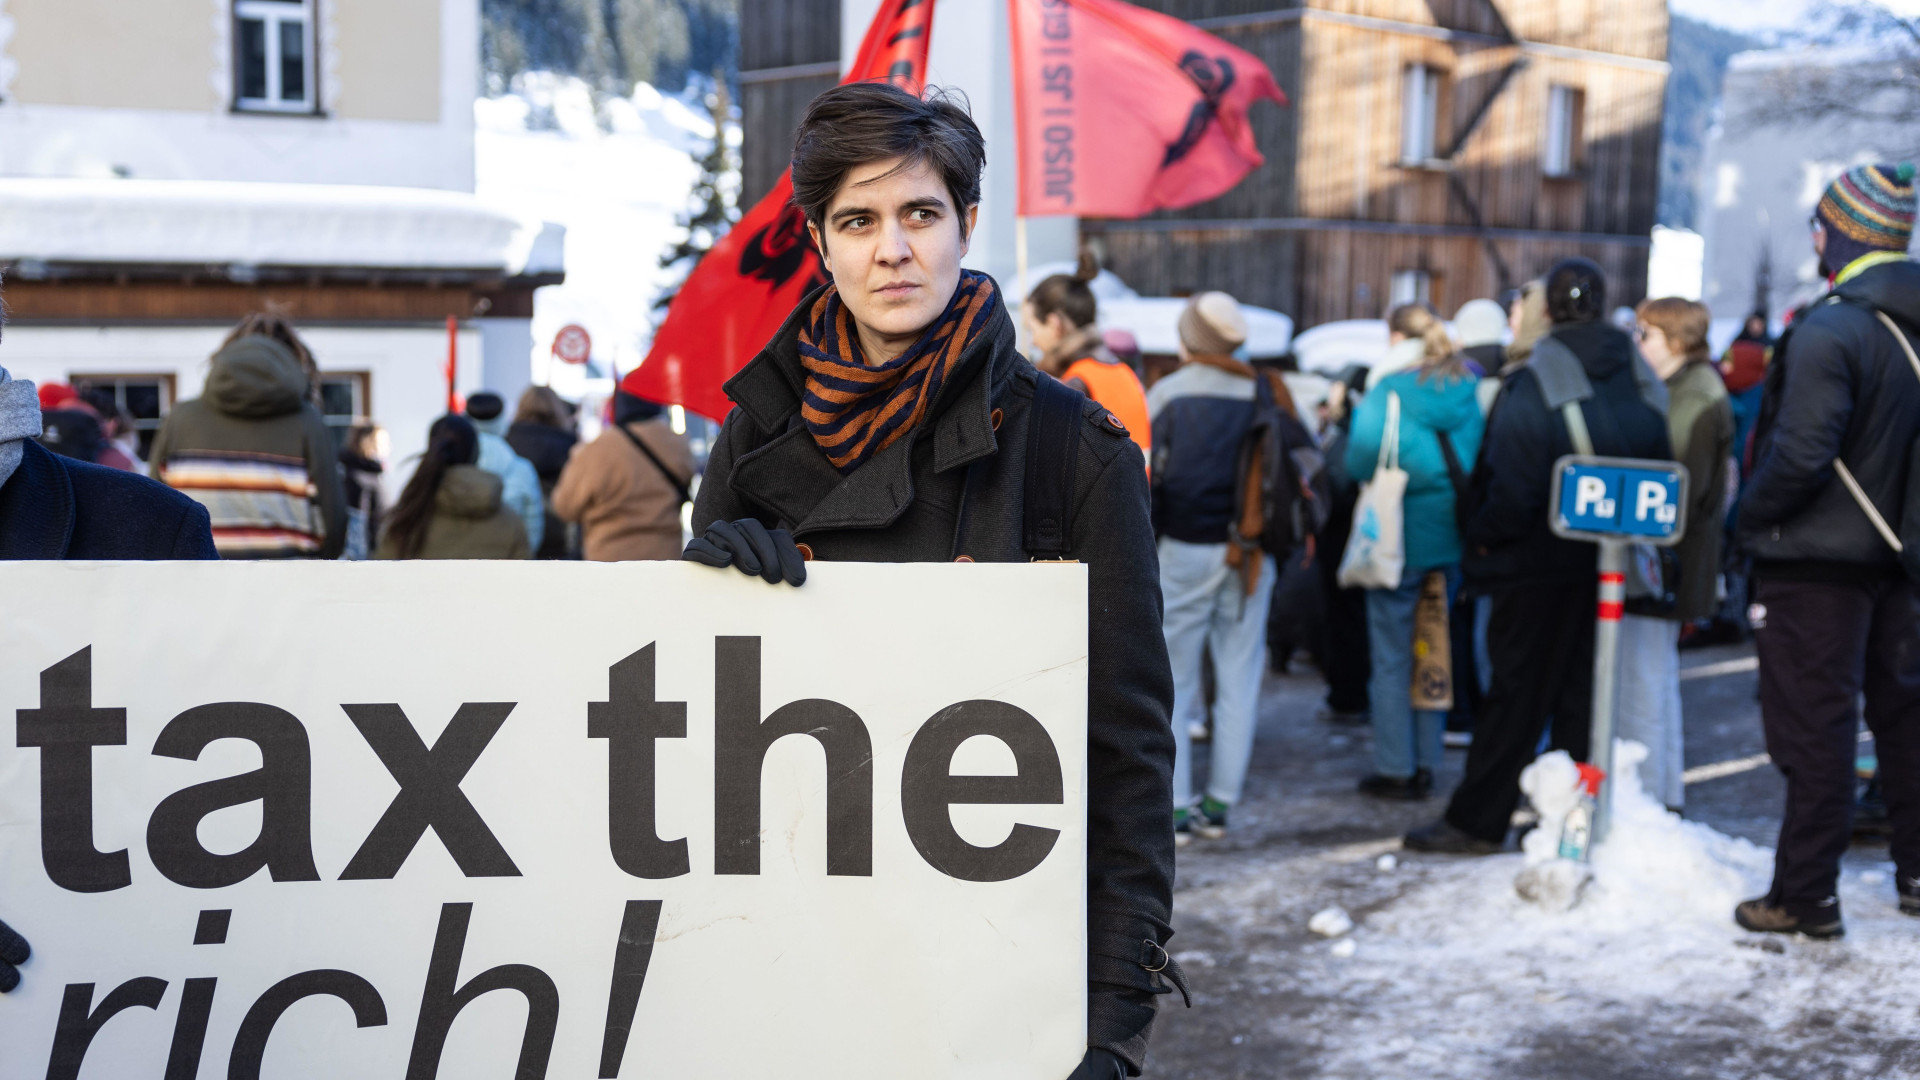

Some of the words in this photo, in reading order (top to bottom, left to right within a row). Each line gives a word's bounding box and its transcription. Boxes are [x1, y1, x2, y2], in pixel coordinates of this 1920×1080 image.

[1042, 64, 1073, 101] JS
[1044, 125, 1074, 205] JUSO
[16, 644, 523, 893] tax
[588, 636, 1064, 882] the
[46, 900, 662, 1080] rich!
